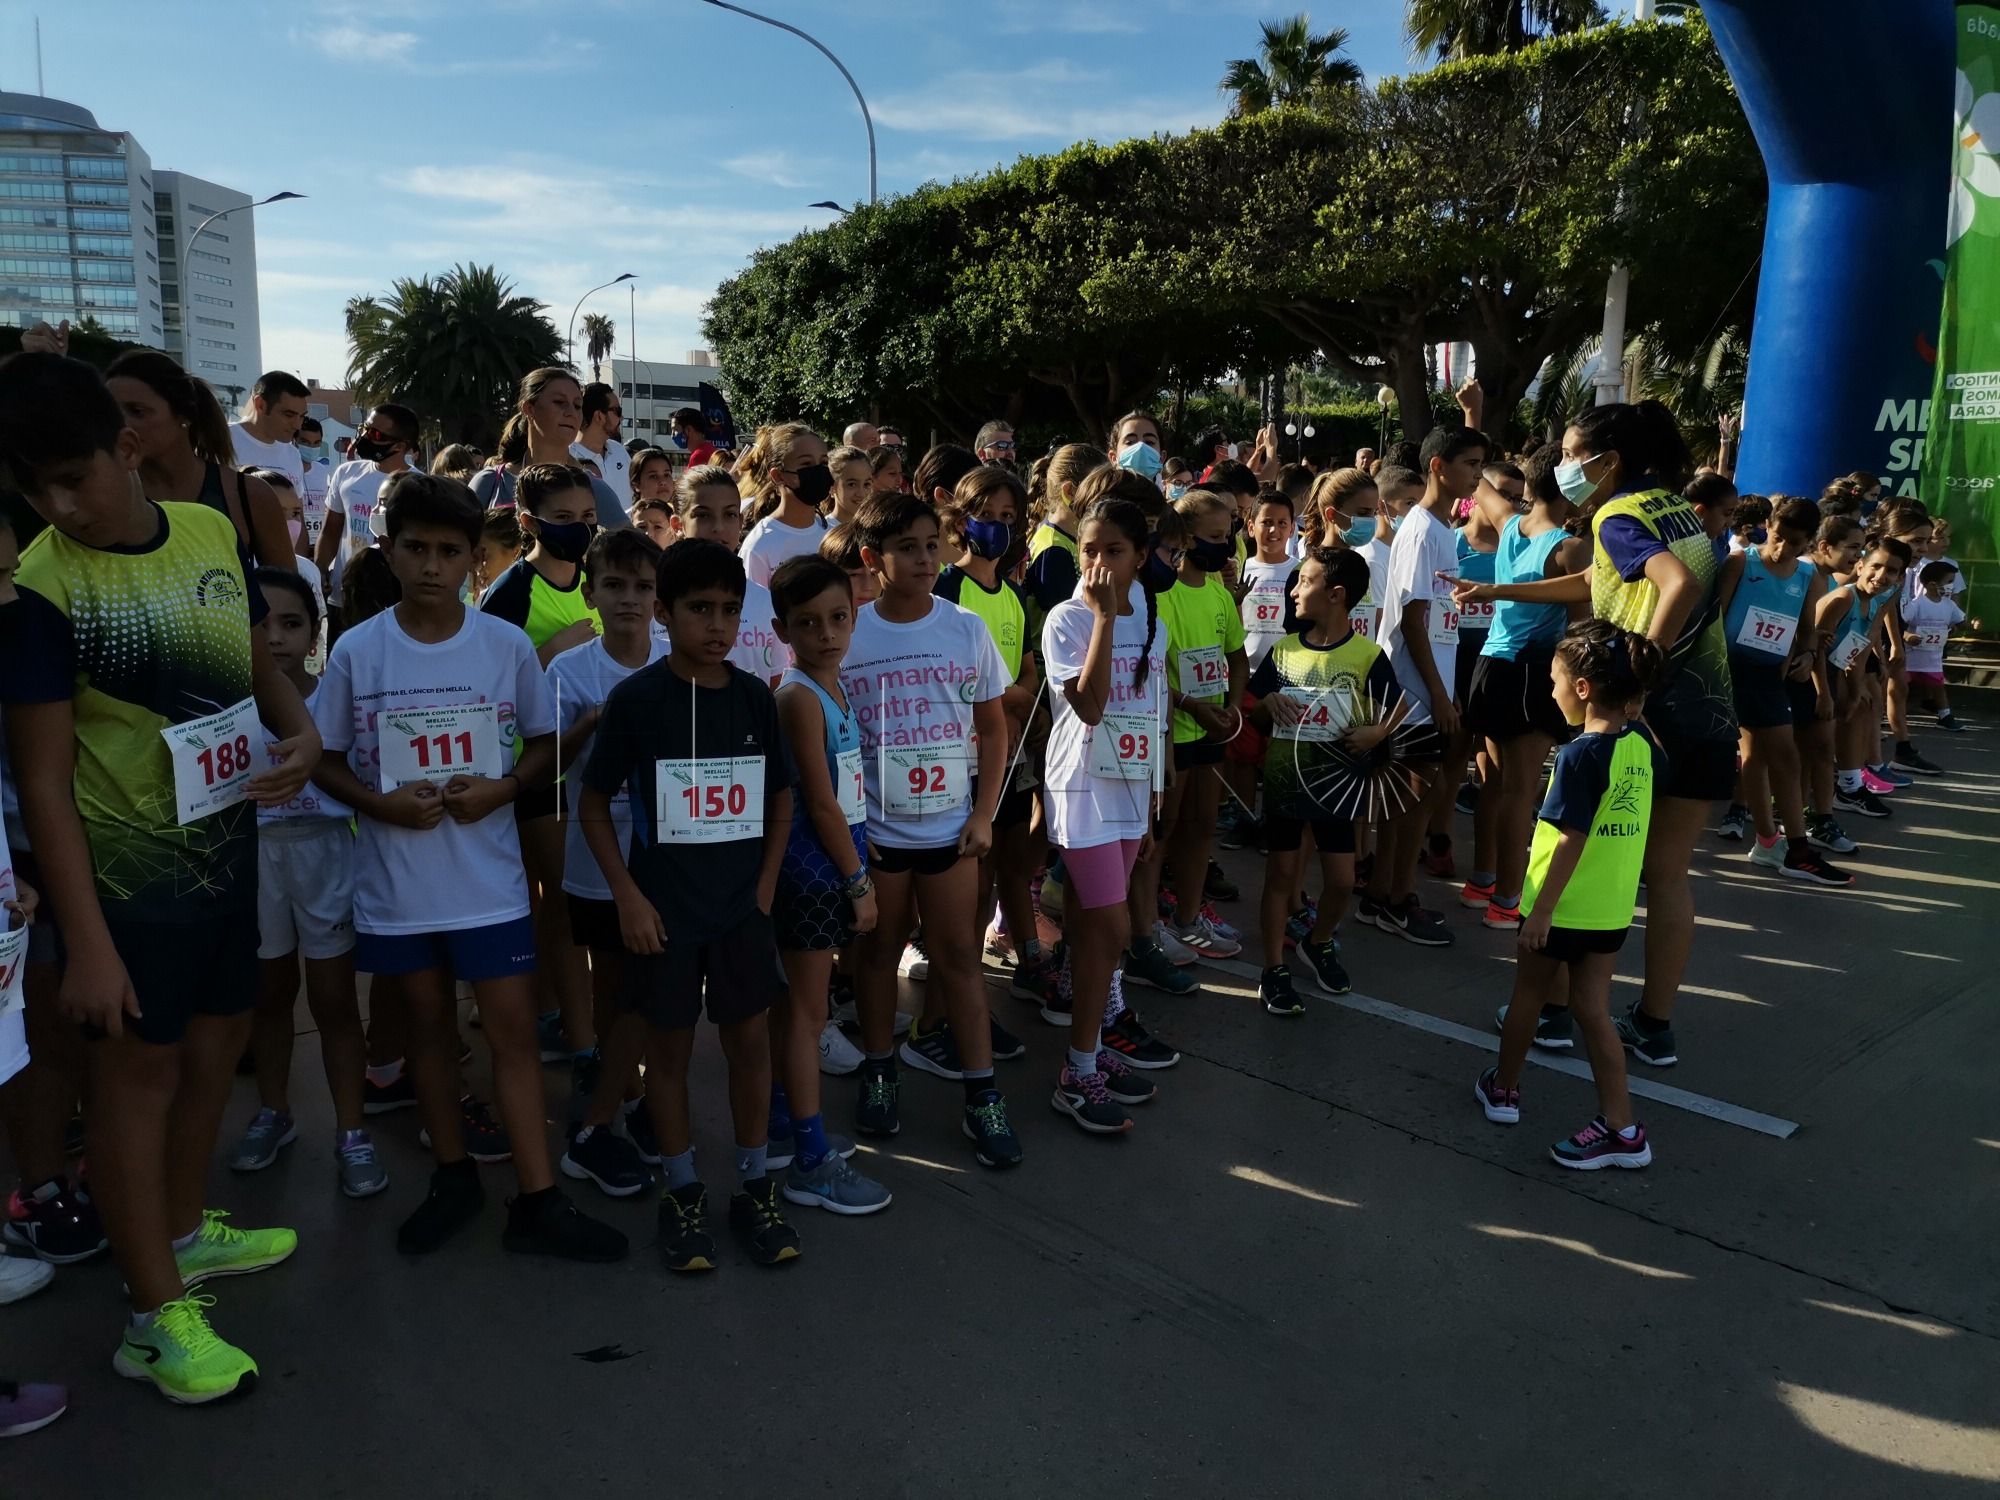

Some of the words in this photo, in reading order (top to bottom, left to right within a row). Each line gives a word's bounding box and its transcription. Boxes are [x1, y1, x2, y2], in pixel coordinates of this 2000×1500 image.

[1256, 604, 1280, 620] 87
[1755, 621, 1786, 642] 157
[445, 685, 472, 693] MELILLA
[877, 660, 977, 690] marcha
[399, 711, 430, 719] CARRERA
[856, 695, 931, 724] ontra
[188, 719, 217, 731] CARRERA
[197, 734, 251, 786] 188
[410, 731, 473, 767] 111
[1118, 733, 1149, 761] 93
[908, 765, 946, 794] 92
[682, 783, 746, 818] 150
